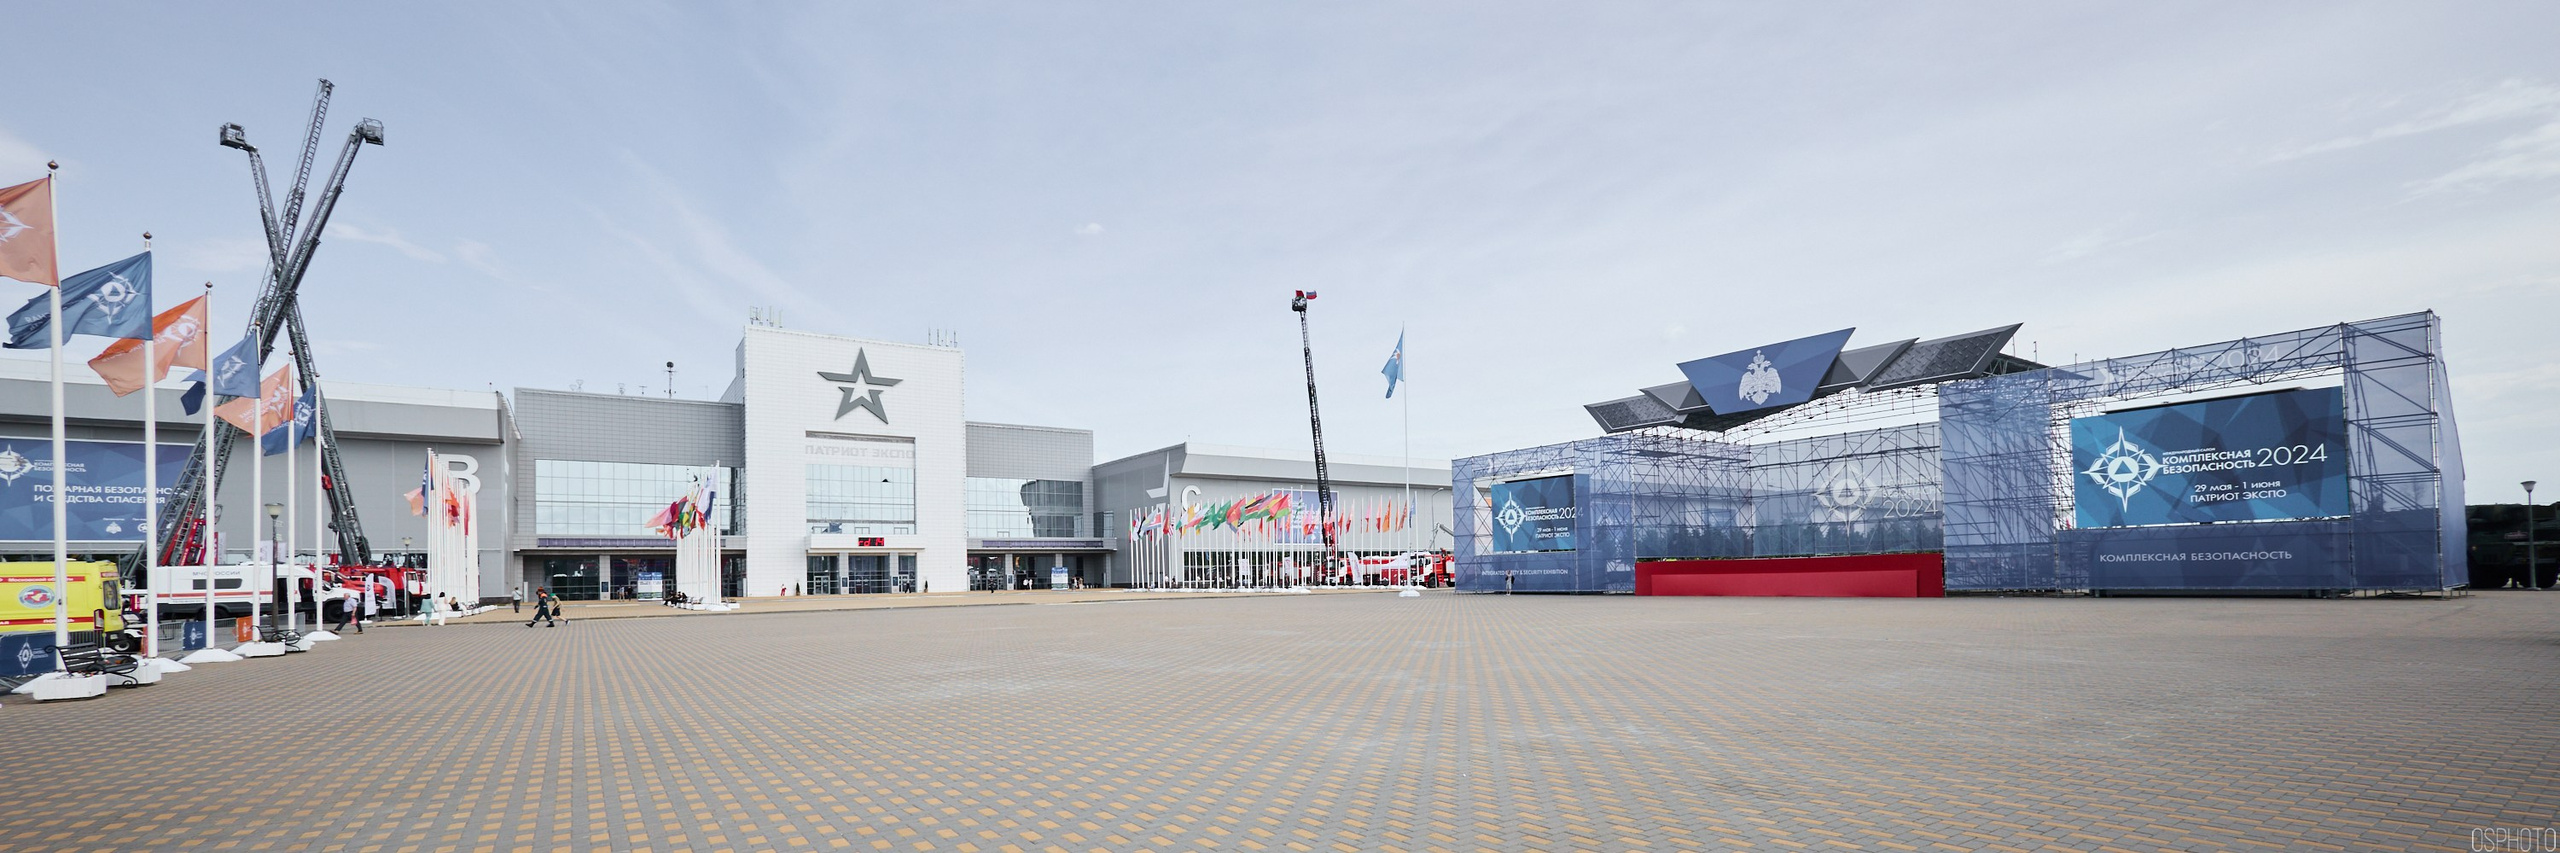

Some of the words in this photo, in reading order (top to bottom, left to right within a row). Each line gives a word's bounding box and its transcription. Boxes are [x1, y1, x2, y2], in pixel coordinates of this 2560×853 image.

[805, 445, 868, 457] ПАТРИОТ
[872, 448, 915, 459] ЭКСПО
[2162, 450, 2252, 465] КОМПЛЕКСНАЯ
[2256, 443, 2328, 468] 2024
[2163, 460, 2256, 475] БЕЗОПАСНОСТЬ
[34, 484, 102, 493] ПОАРНАЯ
[2195, 484, 2207, 493] 29
[2209, 483, 2232, 492] мая
[2243, 481, 2247, 489] 1
[2251, 480, 2281, 489] июня
[2190, 491, 2240, 503] ПАТРИОТ
[2242, 489, 2287, 500] ЭКСПО
[1882, 498, 1939, 519] 2024
[1525, 513, 1559, 521] БЕЗОПАСНОСТЬ
[2100, 553, 2186, 563] КОМПЛЕКСНАЯ
[2191, 551, 2292, 561] БЕЗОПАСНОСТЬ
